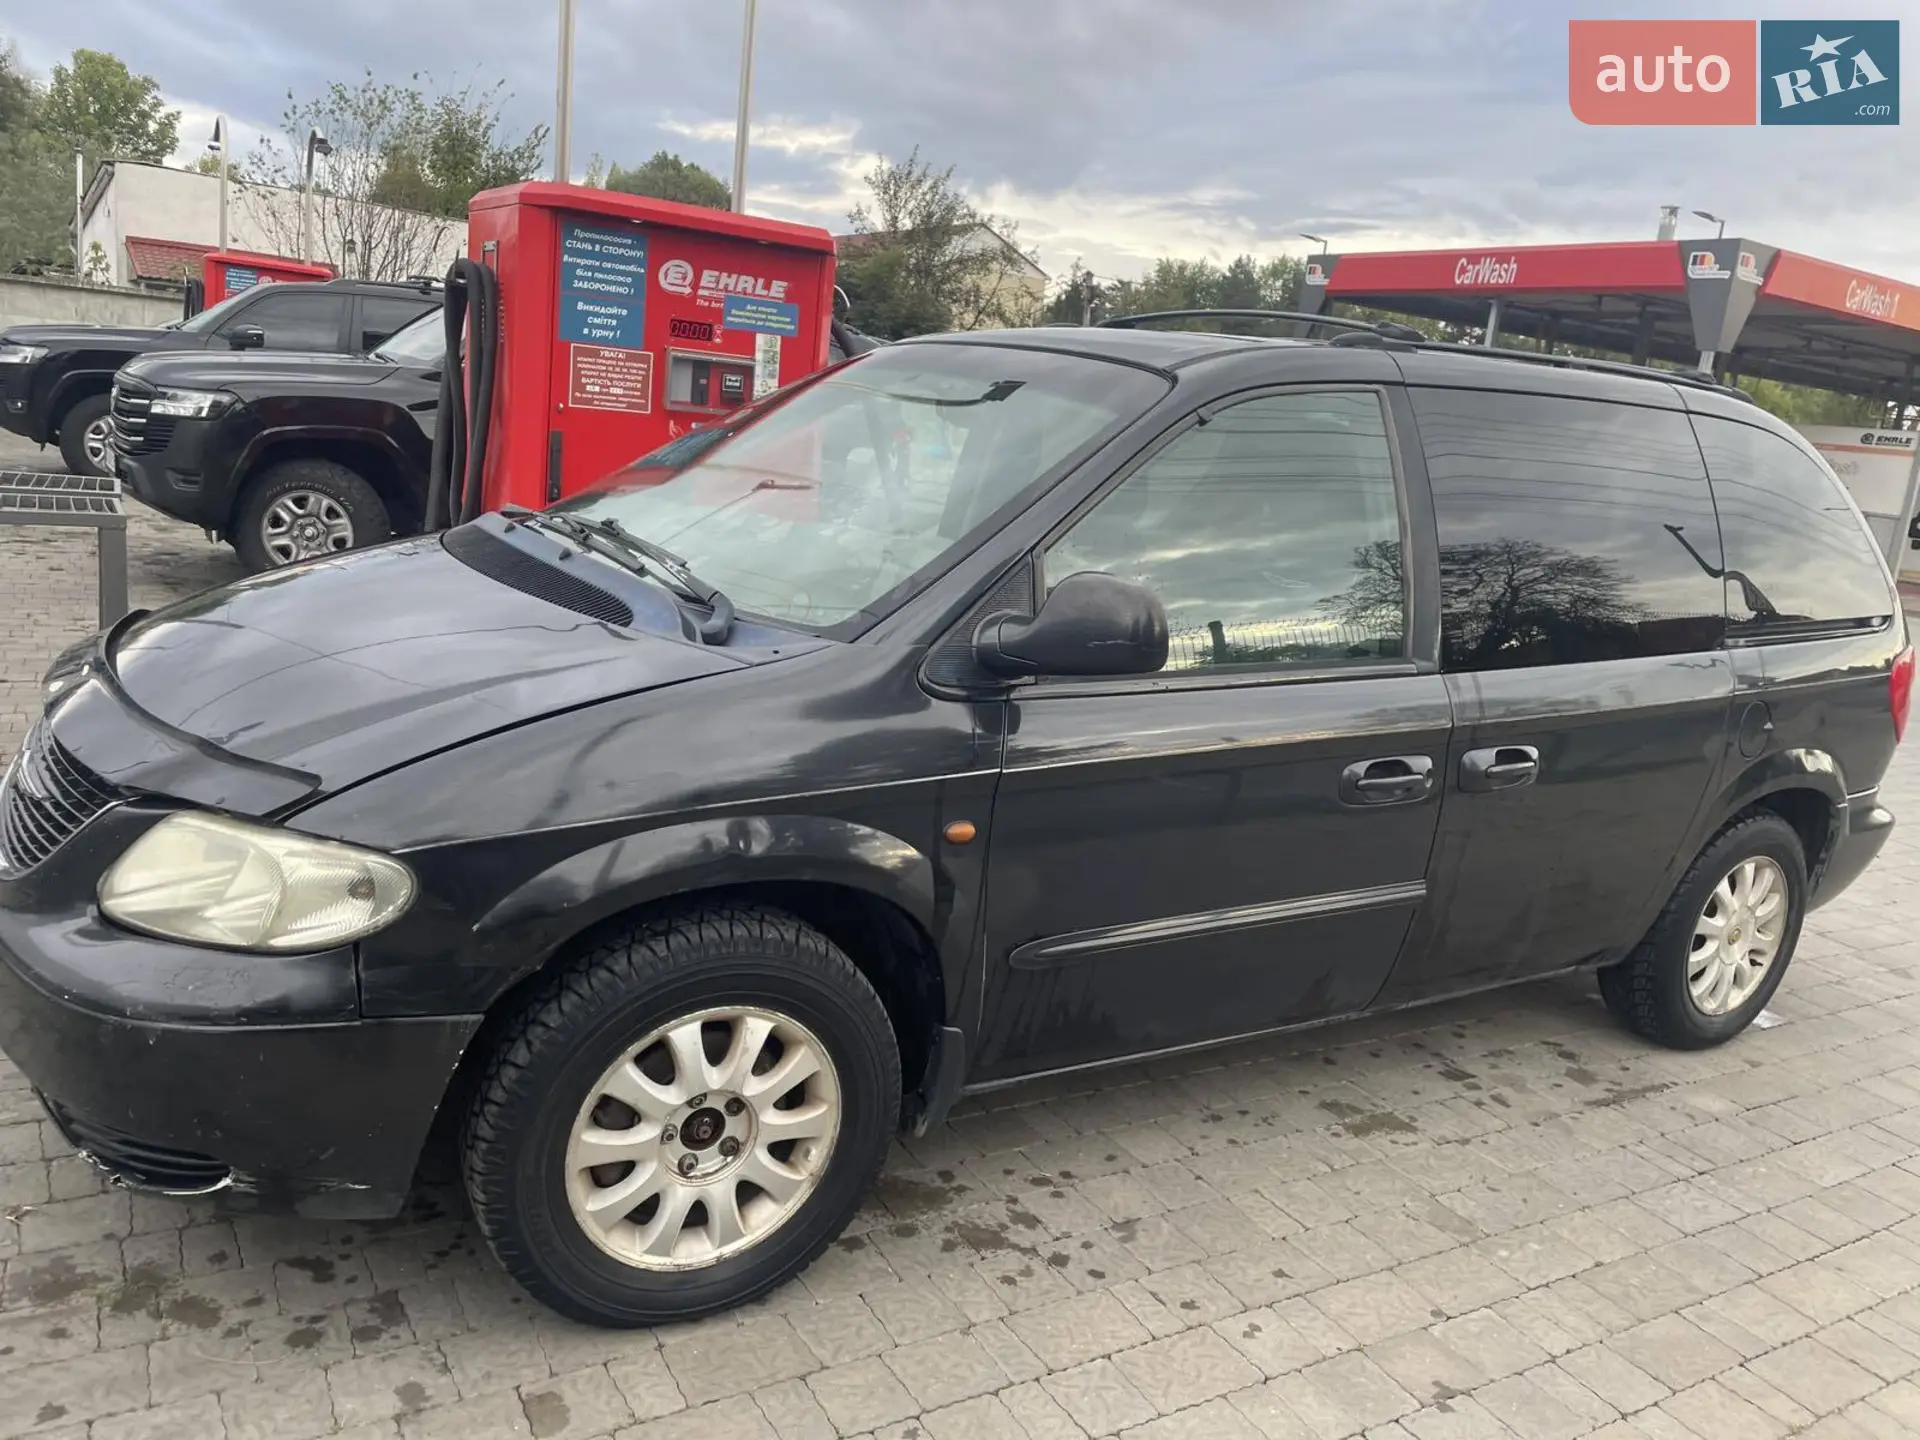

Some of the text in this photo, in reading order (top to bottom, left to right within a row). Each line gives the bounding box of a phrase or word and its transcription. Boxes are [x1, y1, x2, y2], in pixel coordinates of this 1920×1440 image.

[565, 240, 593, 251] СТАНЬ
[602, 245, 644, 259] СТОРОНУ!
[1454, 255, 1508, 285] CarWash
[572, 280, 629, 295] ЗАБОРОНЕНО
[699, 269, 788, 299] EHRLE
[1846, 279, 1891, 317] CarWash
[577, 301, 628, 316] Викидайте
[587, 315, 617, 326] сміття
[591, 328, 615, 339] урну
